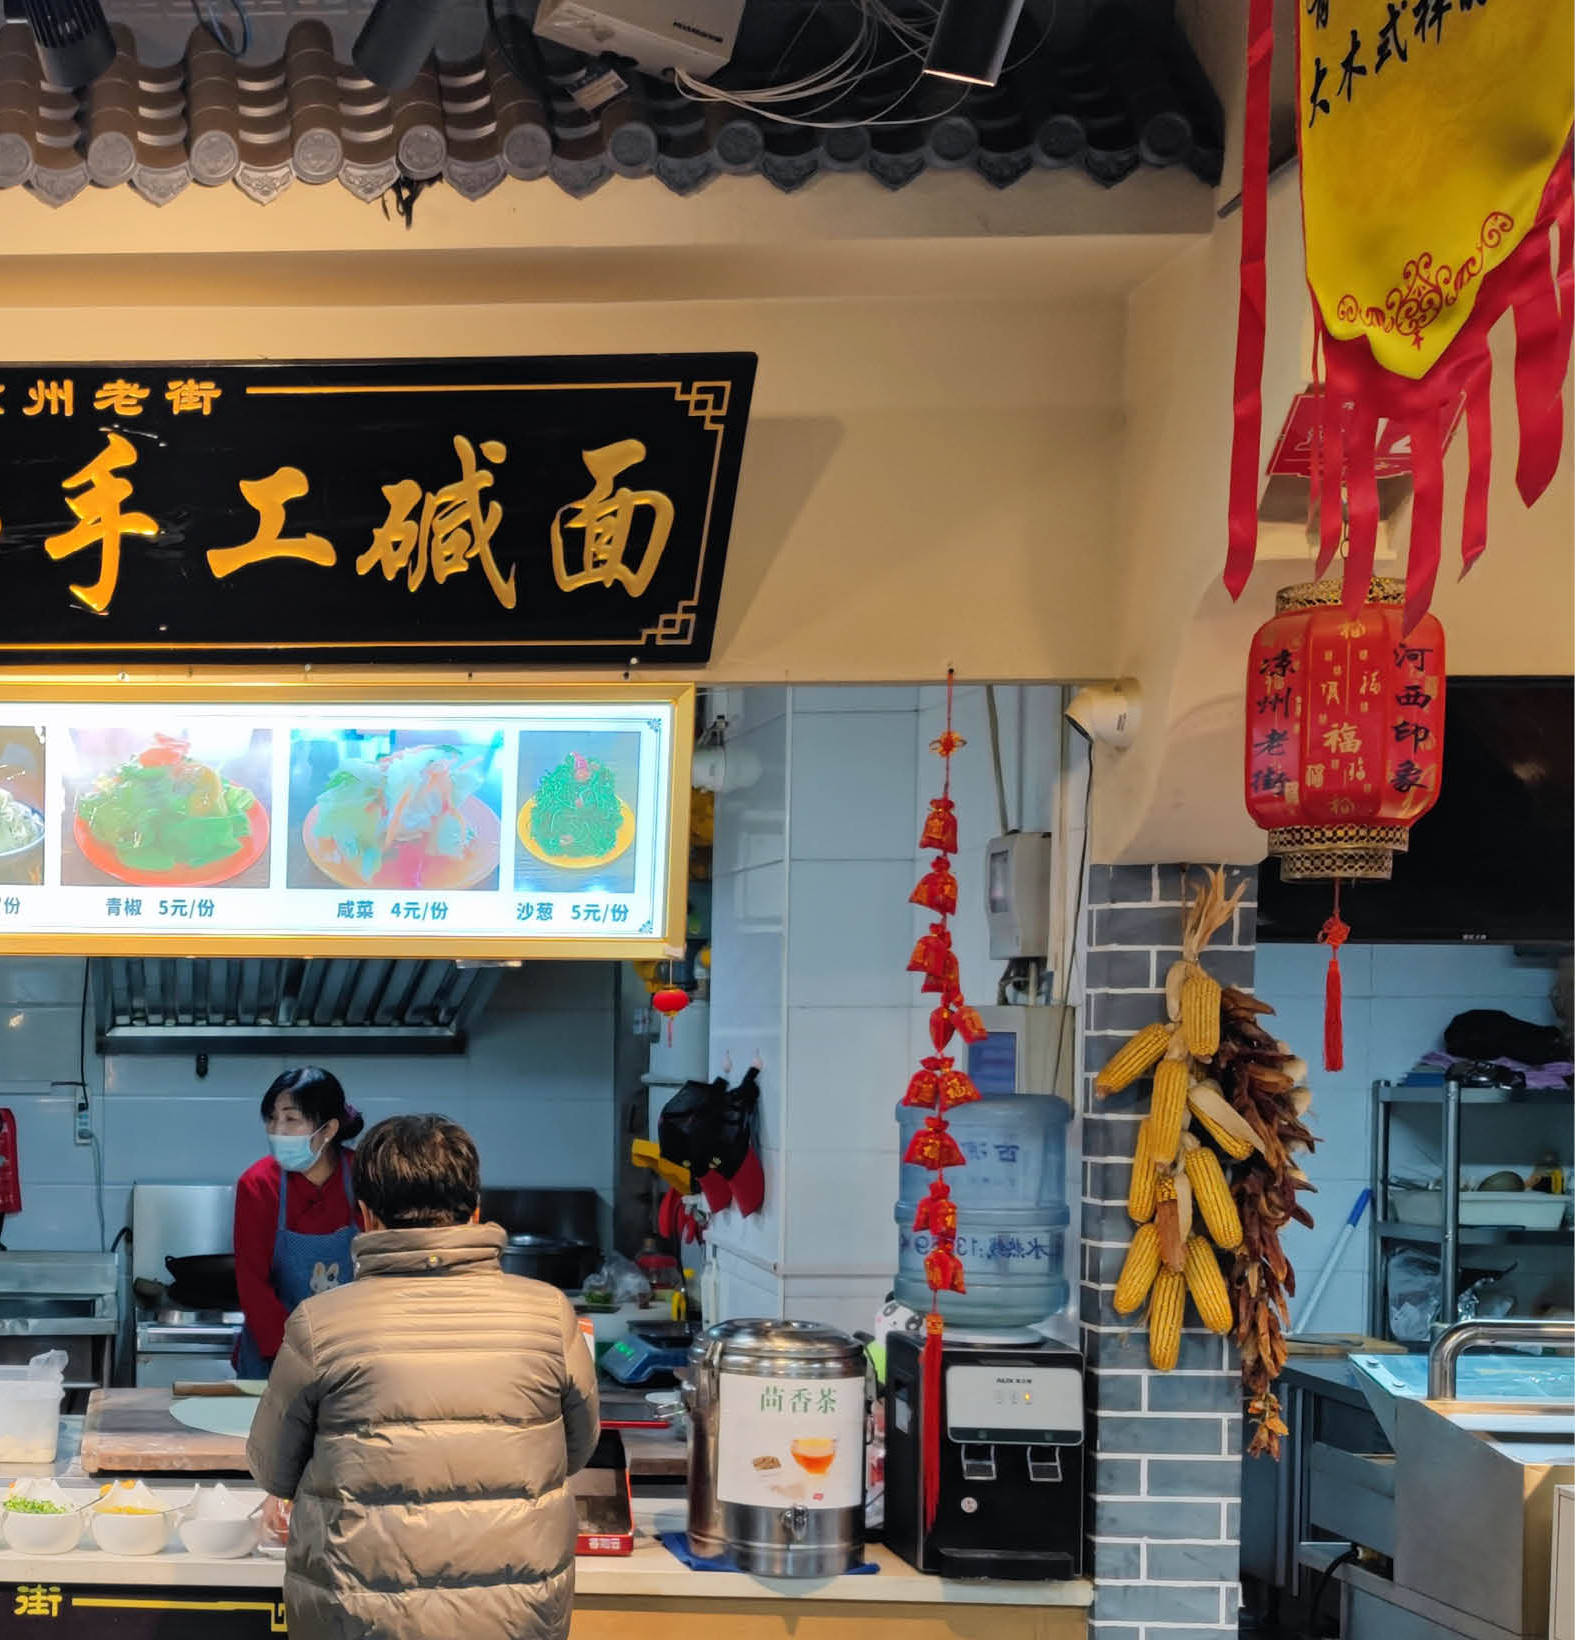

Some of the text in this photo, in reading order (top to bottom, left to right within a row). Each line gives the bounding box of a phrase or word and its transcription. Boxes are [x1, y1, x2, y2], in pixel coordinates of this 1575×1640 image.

[1250, 648, 1296, 797] 凉州老街
[1390, 643, 1434, 793] 河西印象
[1322, 721, 1363, 754] 福
[105, 897, 215, 919] 青椒 5元/份
[336, 899, 449, 921] 咸菜 4元/份
[516, 902, 629, 923] 沙葱 5元/份
